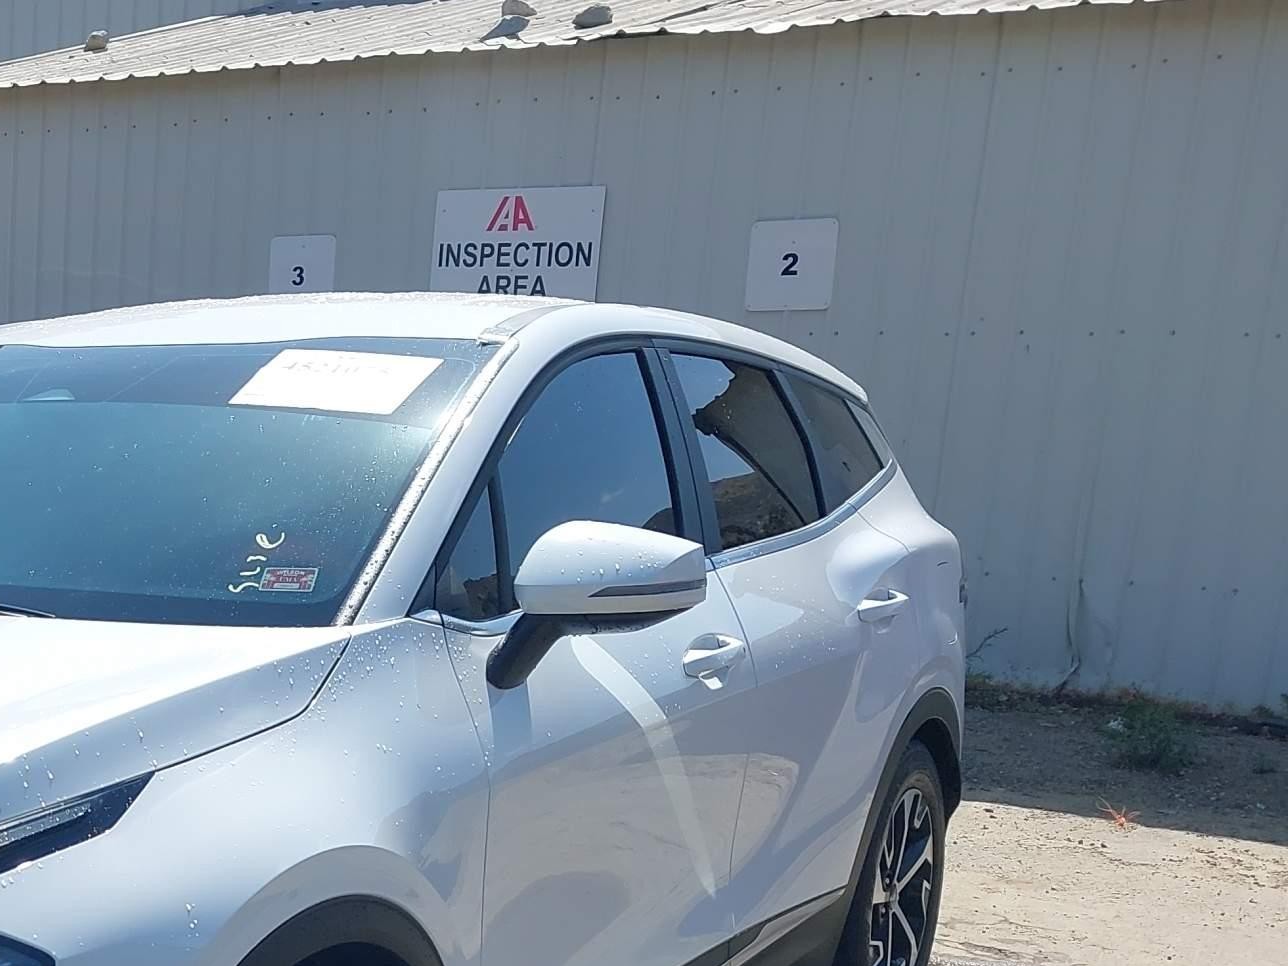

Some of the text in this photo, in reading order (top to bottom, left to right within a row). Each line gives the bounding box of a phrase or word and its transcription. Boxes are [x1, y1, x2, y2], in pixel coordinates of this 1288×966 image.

[438, 241, 593, 268] INSPECTION
[781, 252, 799, 276] 2
[292, 266, 305, 286] 3
[477, 275, 547, 296] AREA
